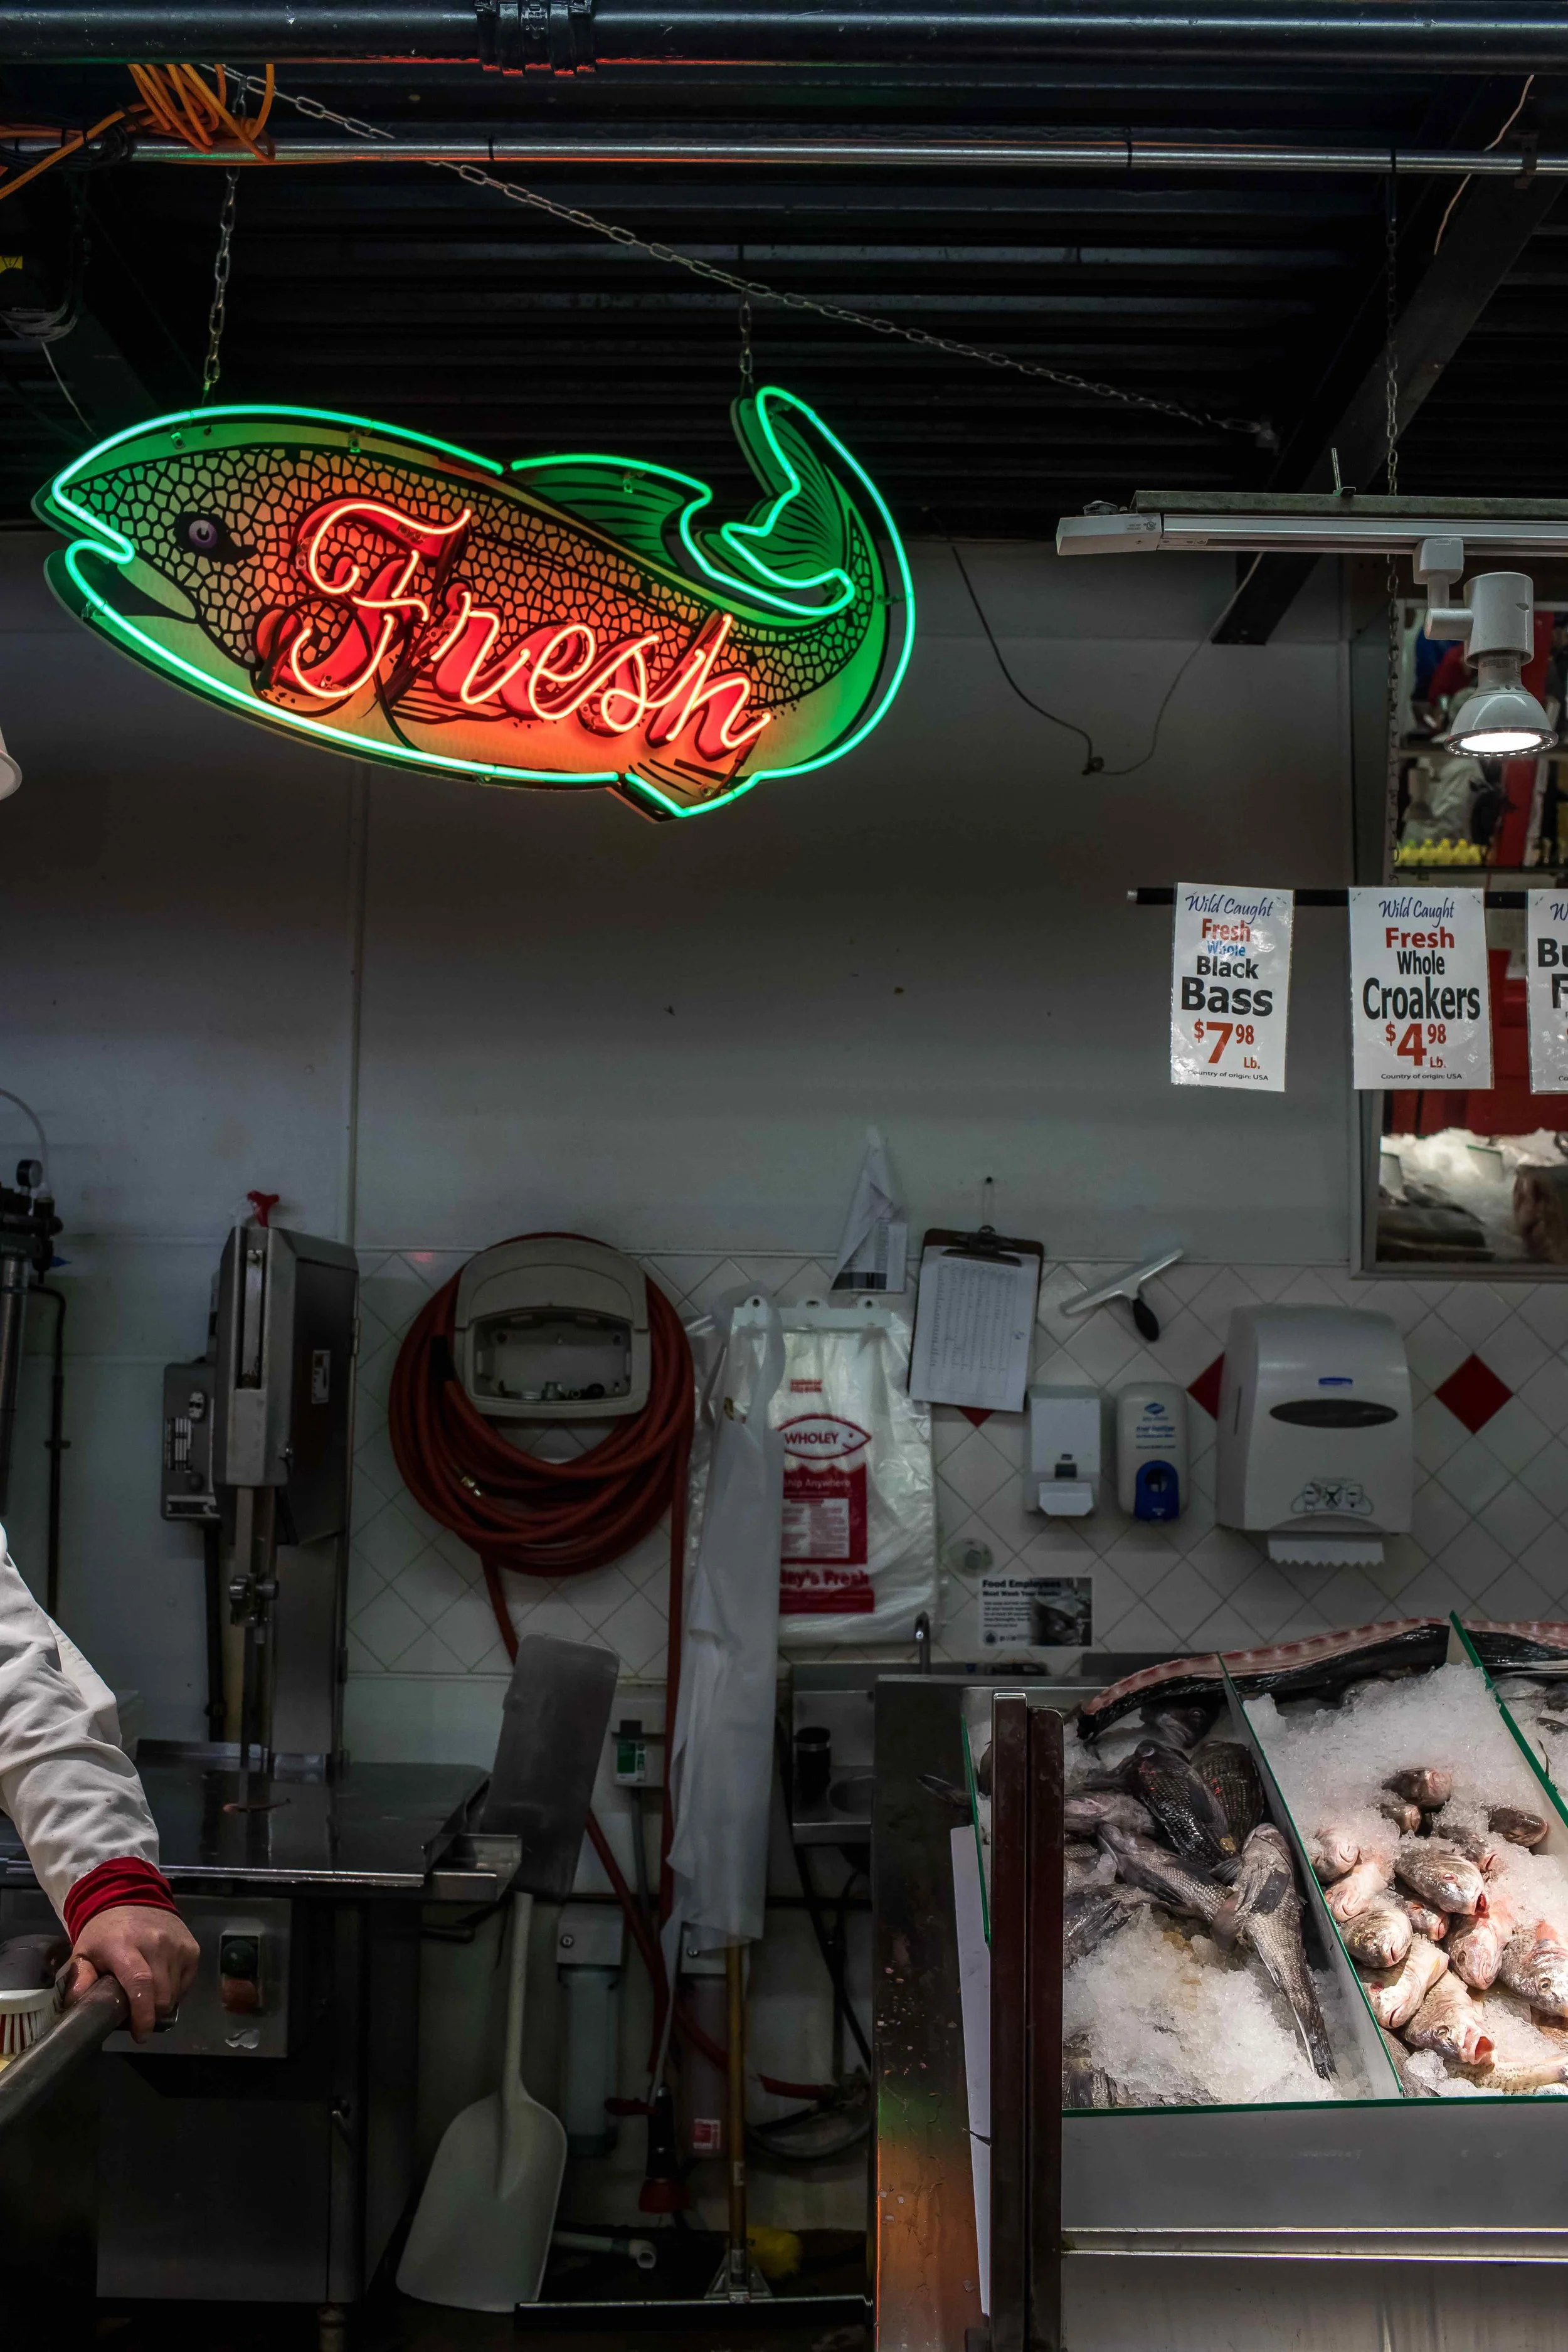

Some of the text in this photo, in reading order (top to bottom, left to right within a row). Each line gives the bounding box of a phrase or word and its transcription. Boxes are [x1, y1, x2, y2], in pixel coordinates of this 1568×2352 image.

[285, 501, 771, 750] Fresh
[1185, 893, 1274, 924] Wild Caught
[1379, 896, 1455, 928] Wild Caught
[1202, 918, 1251, 942] Fresh
[1385, 926, 1455, 948] Fresh
[1197, 955, 1259, 979] Black
[1397, 950, 1445, 975] Whole
[1181, 976, 1273, 1017] Bass
[1362, 976, 1481, 1020] Croakers
[1244, 1057, 1261, 1069] Lb.
[1429, 1056, 1447, 1068] Lb.
[785, 1431, 839, 1444] WHOLEY
[982, 1579, 1006, 1588] Food
